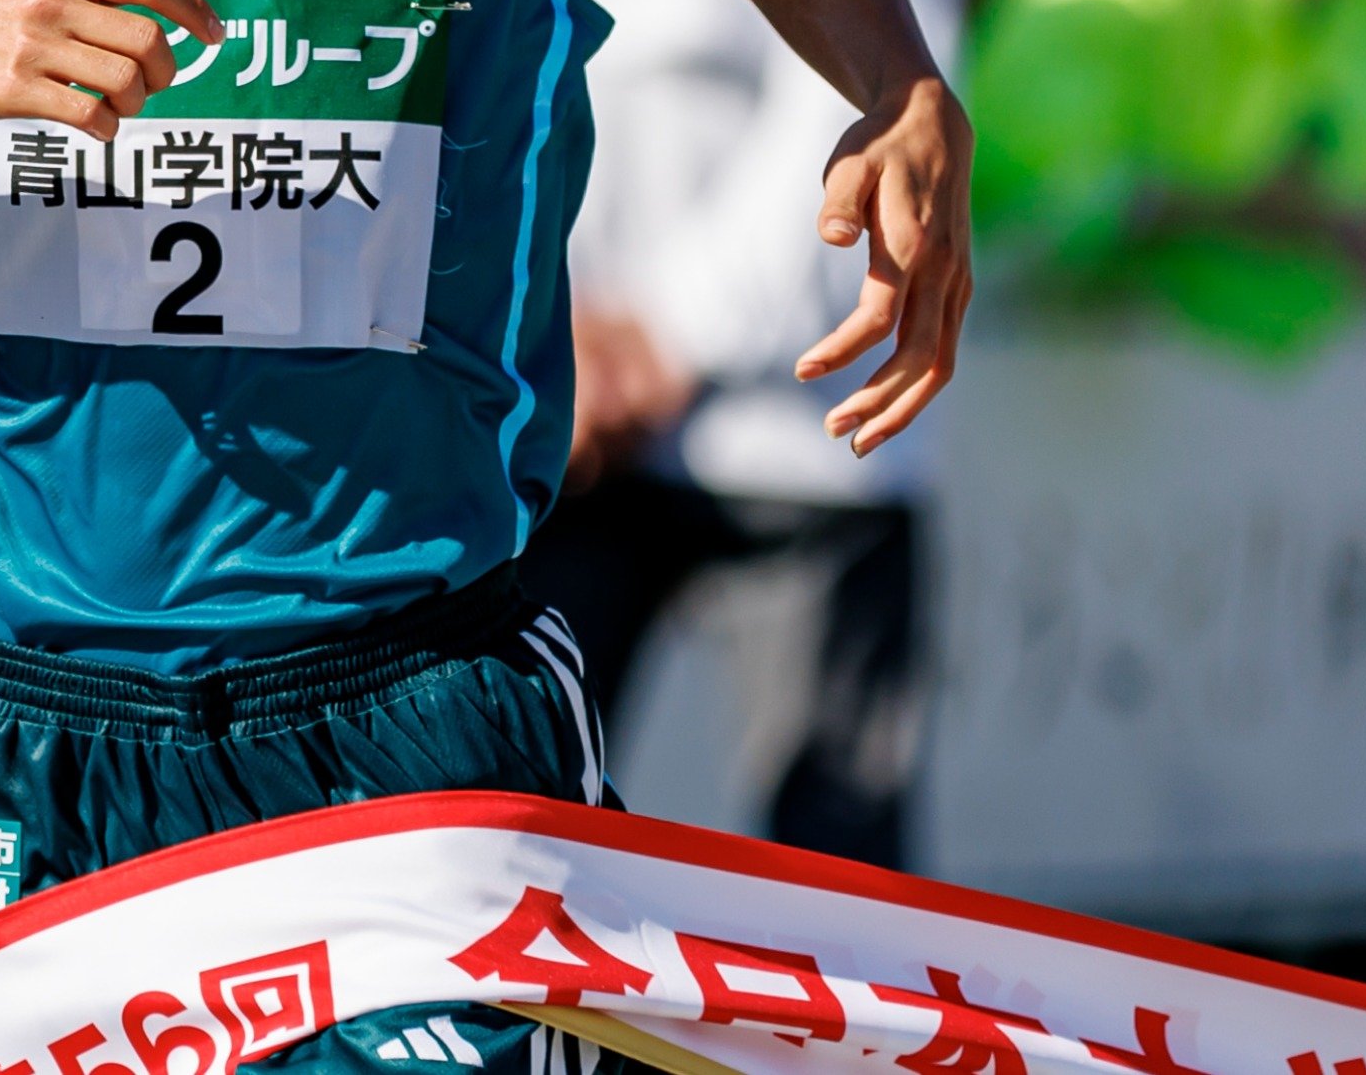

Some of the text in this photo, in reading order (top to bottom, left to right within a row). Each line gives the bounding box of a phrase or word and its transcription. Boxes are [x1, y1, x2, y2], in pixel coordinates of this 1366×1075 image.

[7, 130, 382, 211] 青山学院大
[149, 220, 224, 335] 2
